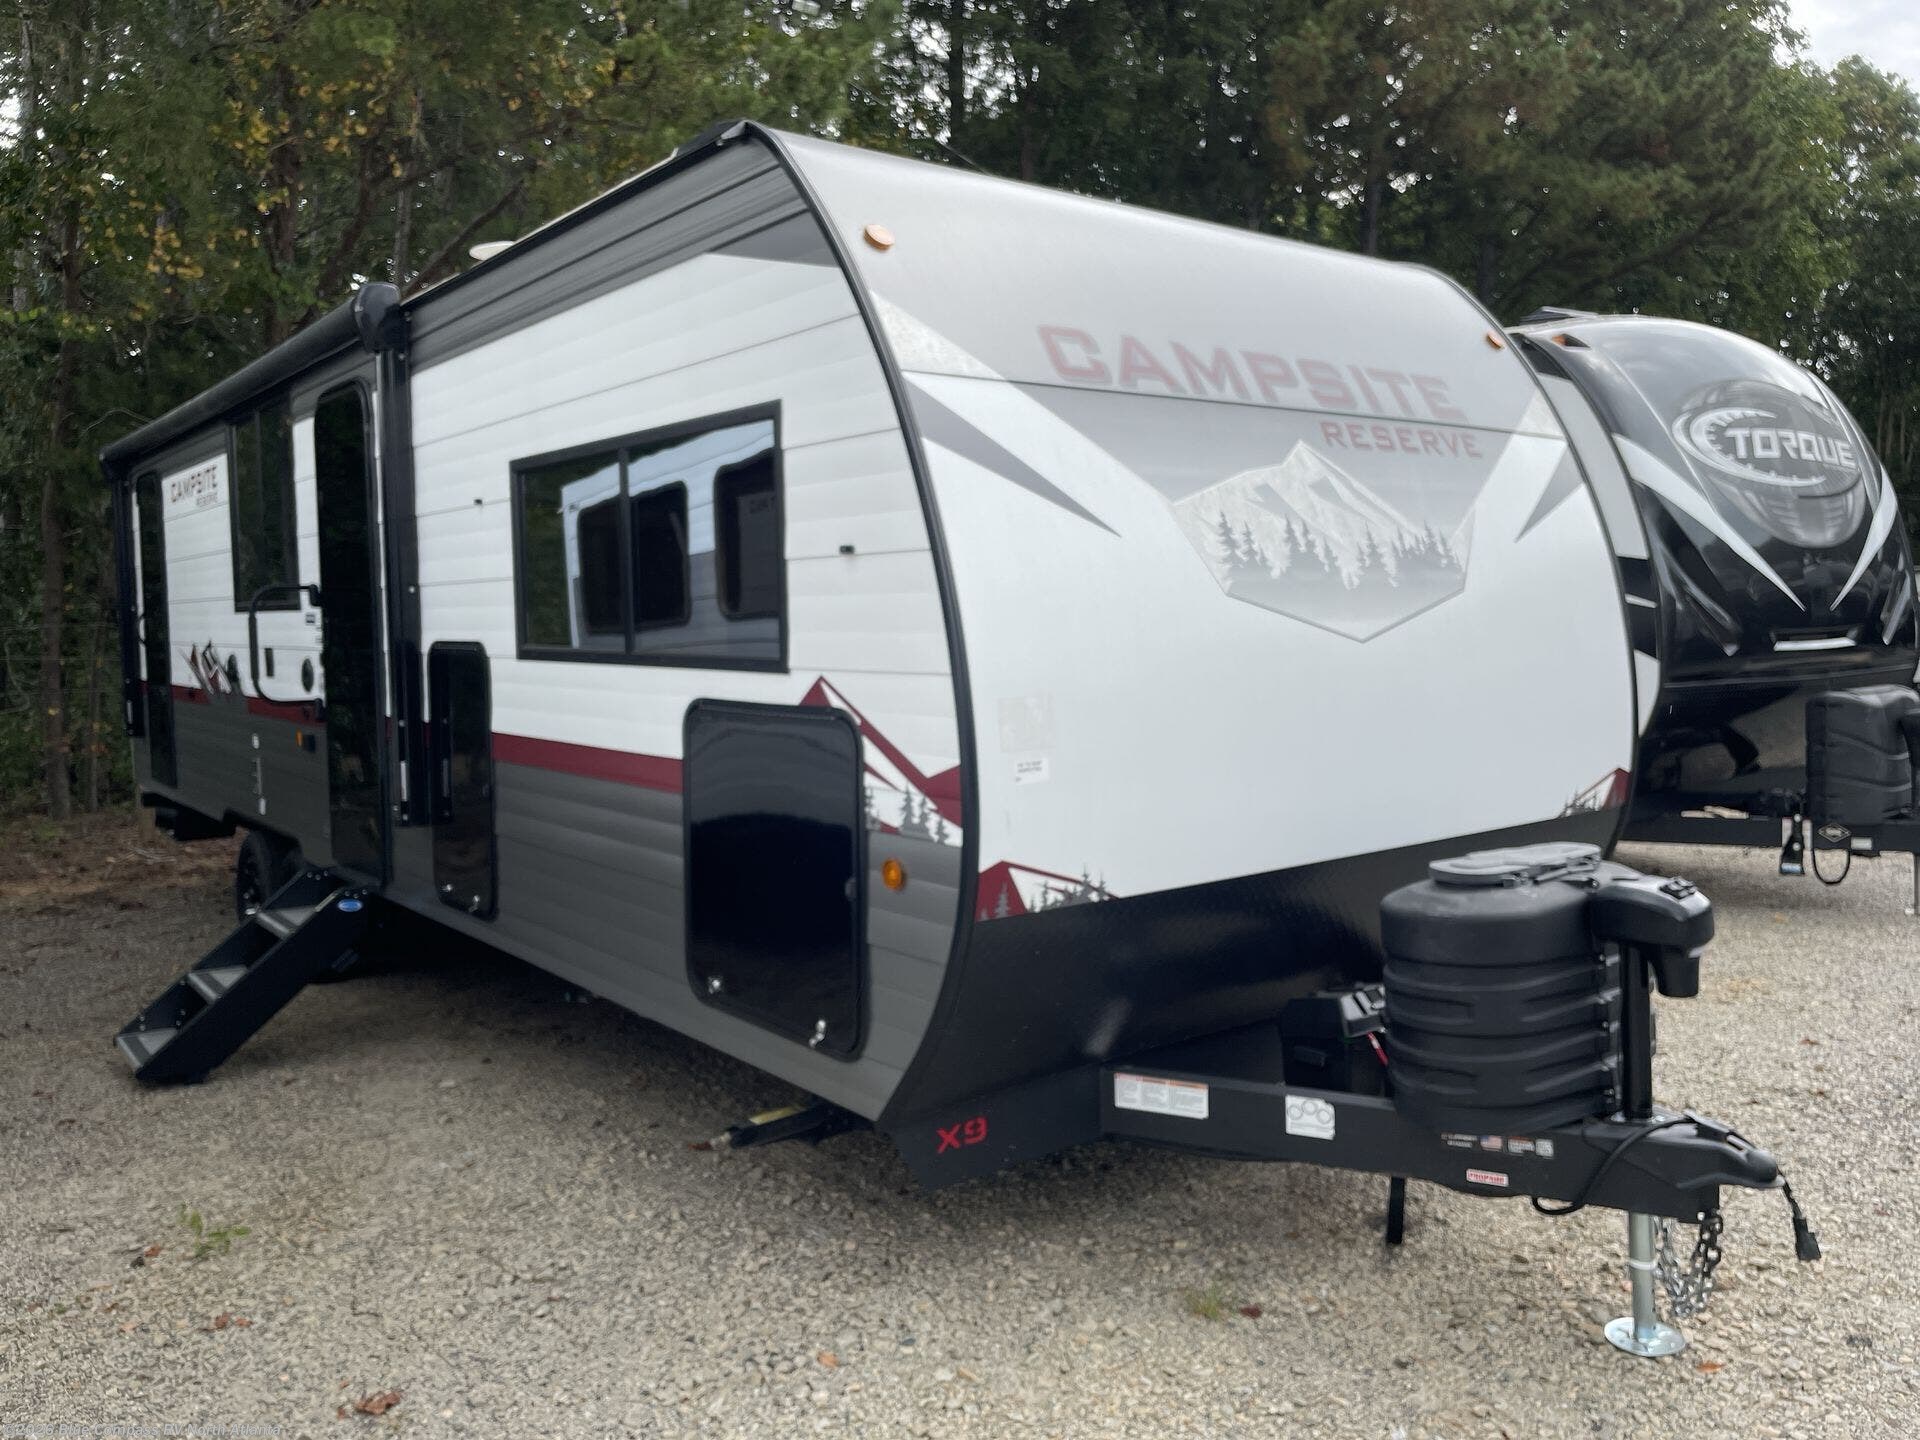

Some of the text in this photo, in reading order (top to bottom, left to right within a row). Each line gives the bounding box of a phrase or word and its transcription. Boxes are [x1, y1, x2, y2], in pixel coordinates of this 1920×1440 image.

[1037, 325, 1469, 423] CAMPSITE
[1320, 421, 1484, 459] RESERVE
[1725, 427, 1856, 467] TORQUE
[171, 465, 217, 503] CAMPSITE
[936, 1116, 987, 1153] X9
